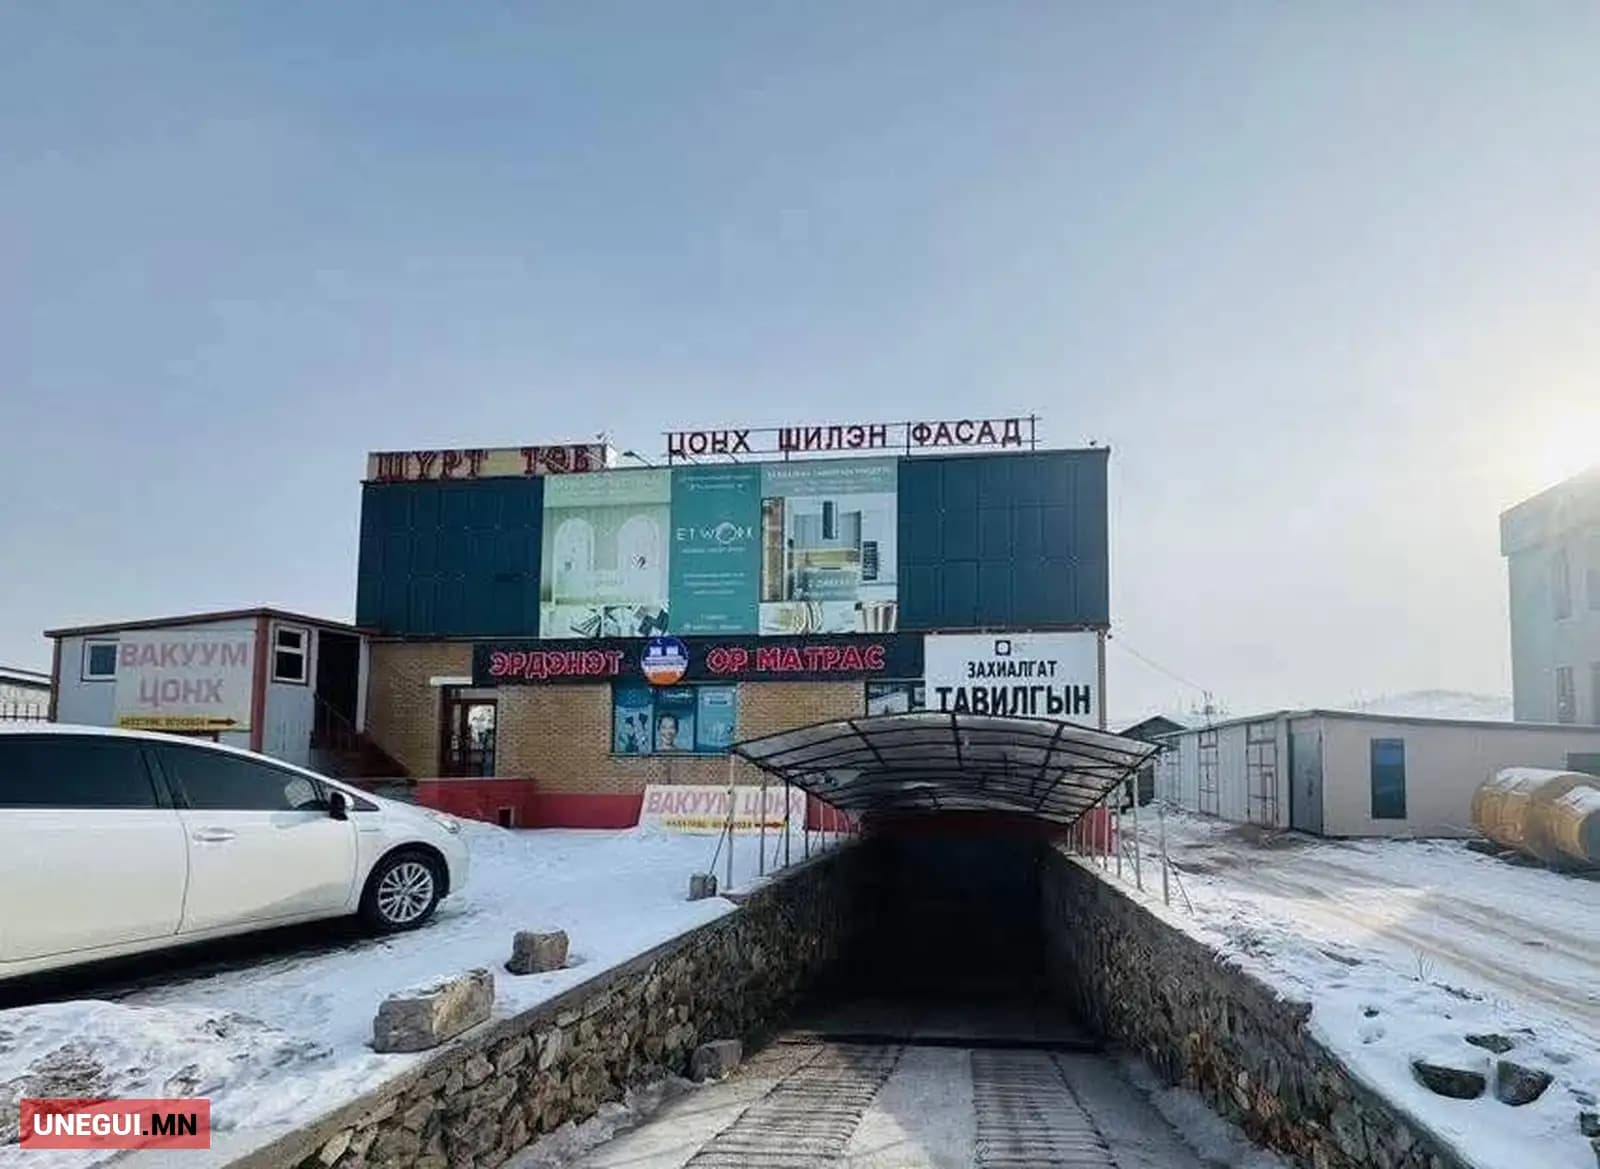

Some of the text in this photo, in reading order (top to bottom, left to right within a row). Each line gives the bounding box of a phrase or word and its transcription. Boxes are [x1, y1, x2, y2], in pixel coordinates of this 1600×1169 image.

[668, 419, 1022, 460] ЦОНХ ШИЛЭН ФАСАД
[121, 642, 248, 668] ВАКУУМ
[488, 645, 886, 679] ЭРДЭНЭТ ОР МАТРАС
[967, 659, 1058, 679] ЗАХИАЛГАТ
[140, 677, 224, 708] ЦОНХ
[935, 684, 1091, 716] ТАВИЛГЫН
